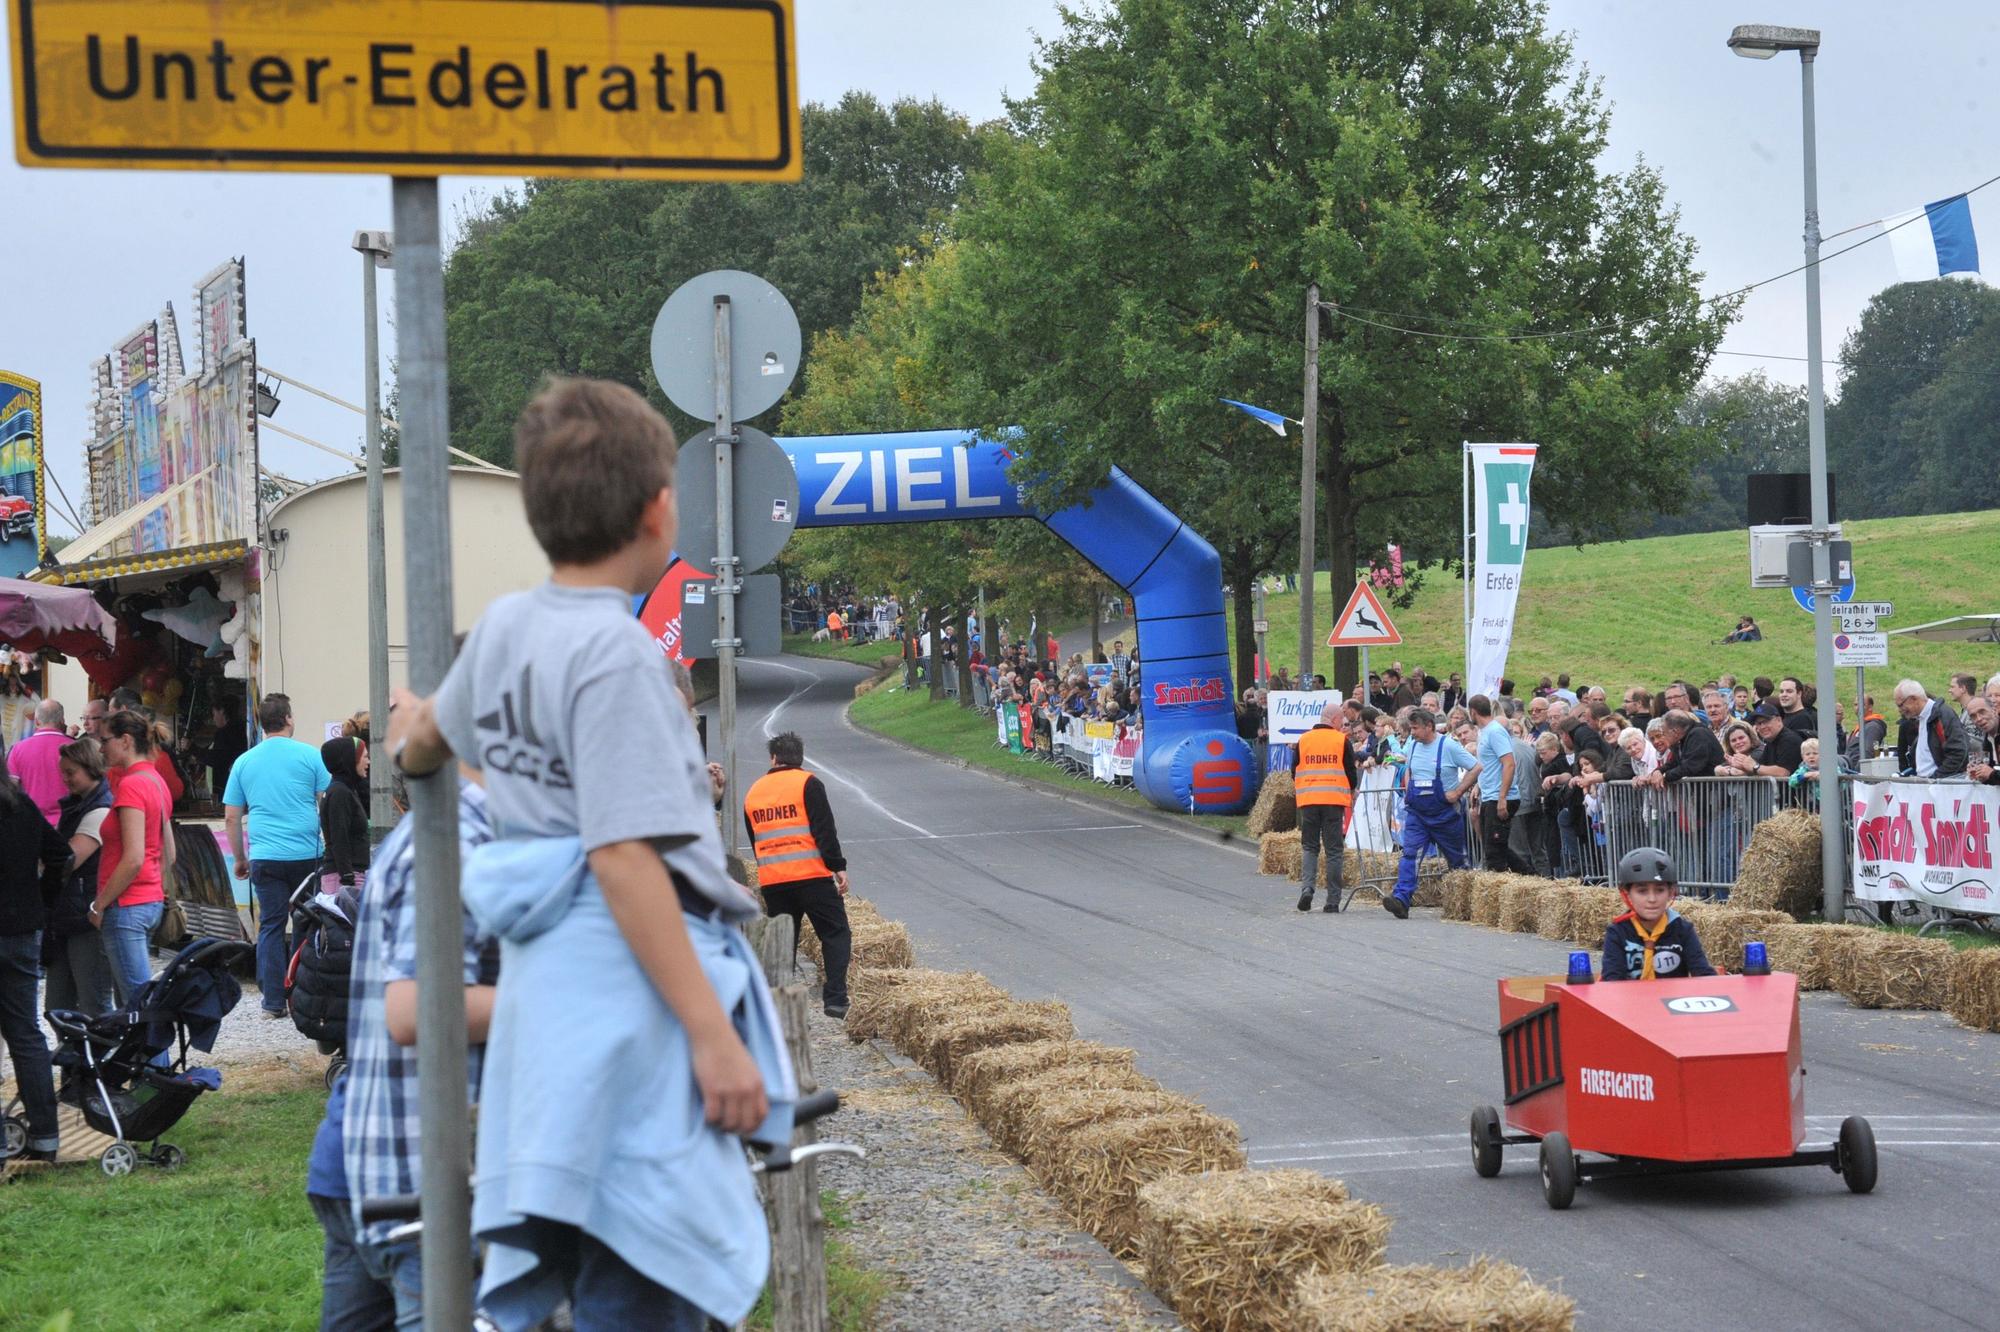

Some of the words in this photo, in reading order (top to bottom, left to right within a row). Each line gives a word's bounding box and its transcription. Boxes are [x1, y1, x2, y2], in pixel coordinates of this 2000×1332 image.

[85, 33, 726, 114] Unter-Edelrath
[814, 446, 1001, 515] ZIEL
[1486, 572, 1513, 590] Erste
[1831, 605, 1868, 615] delrather
[1874, 605, 1891, 615] Weg
[1154, 677, 1226, 706] Smidt
[1276, 697, 1327, 719] Parkplat
[1305, 754, 1338, 765] ORDNER
[752, 804, 798, 824] ORDNER
[1921, 799, 1993, 869] Smidt
[1580, 1067, 1656, 1102] FIREFIGHTER
